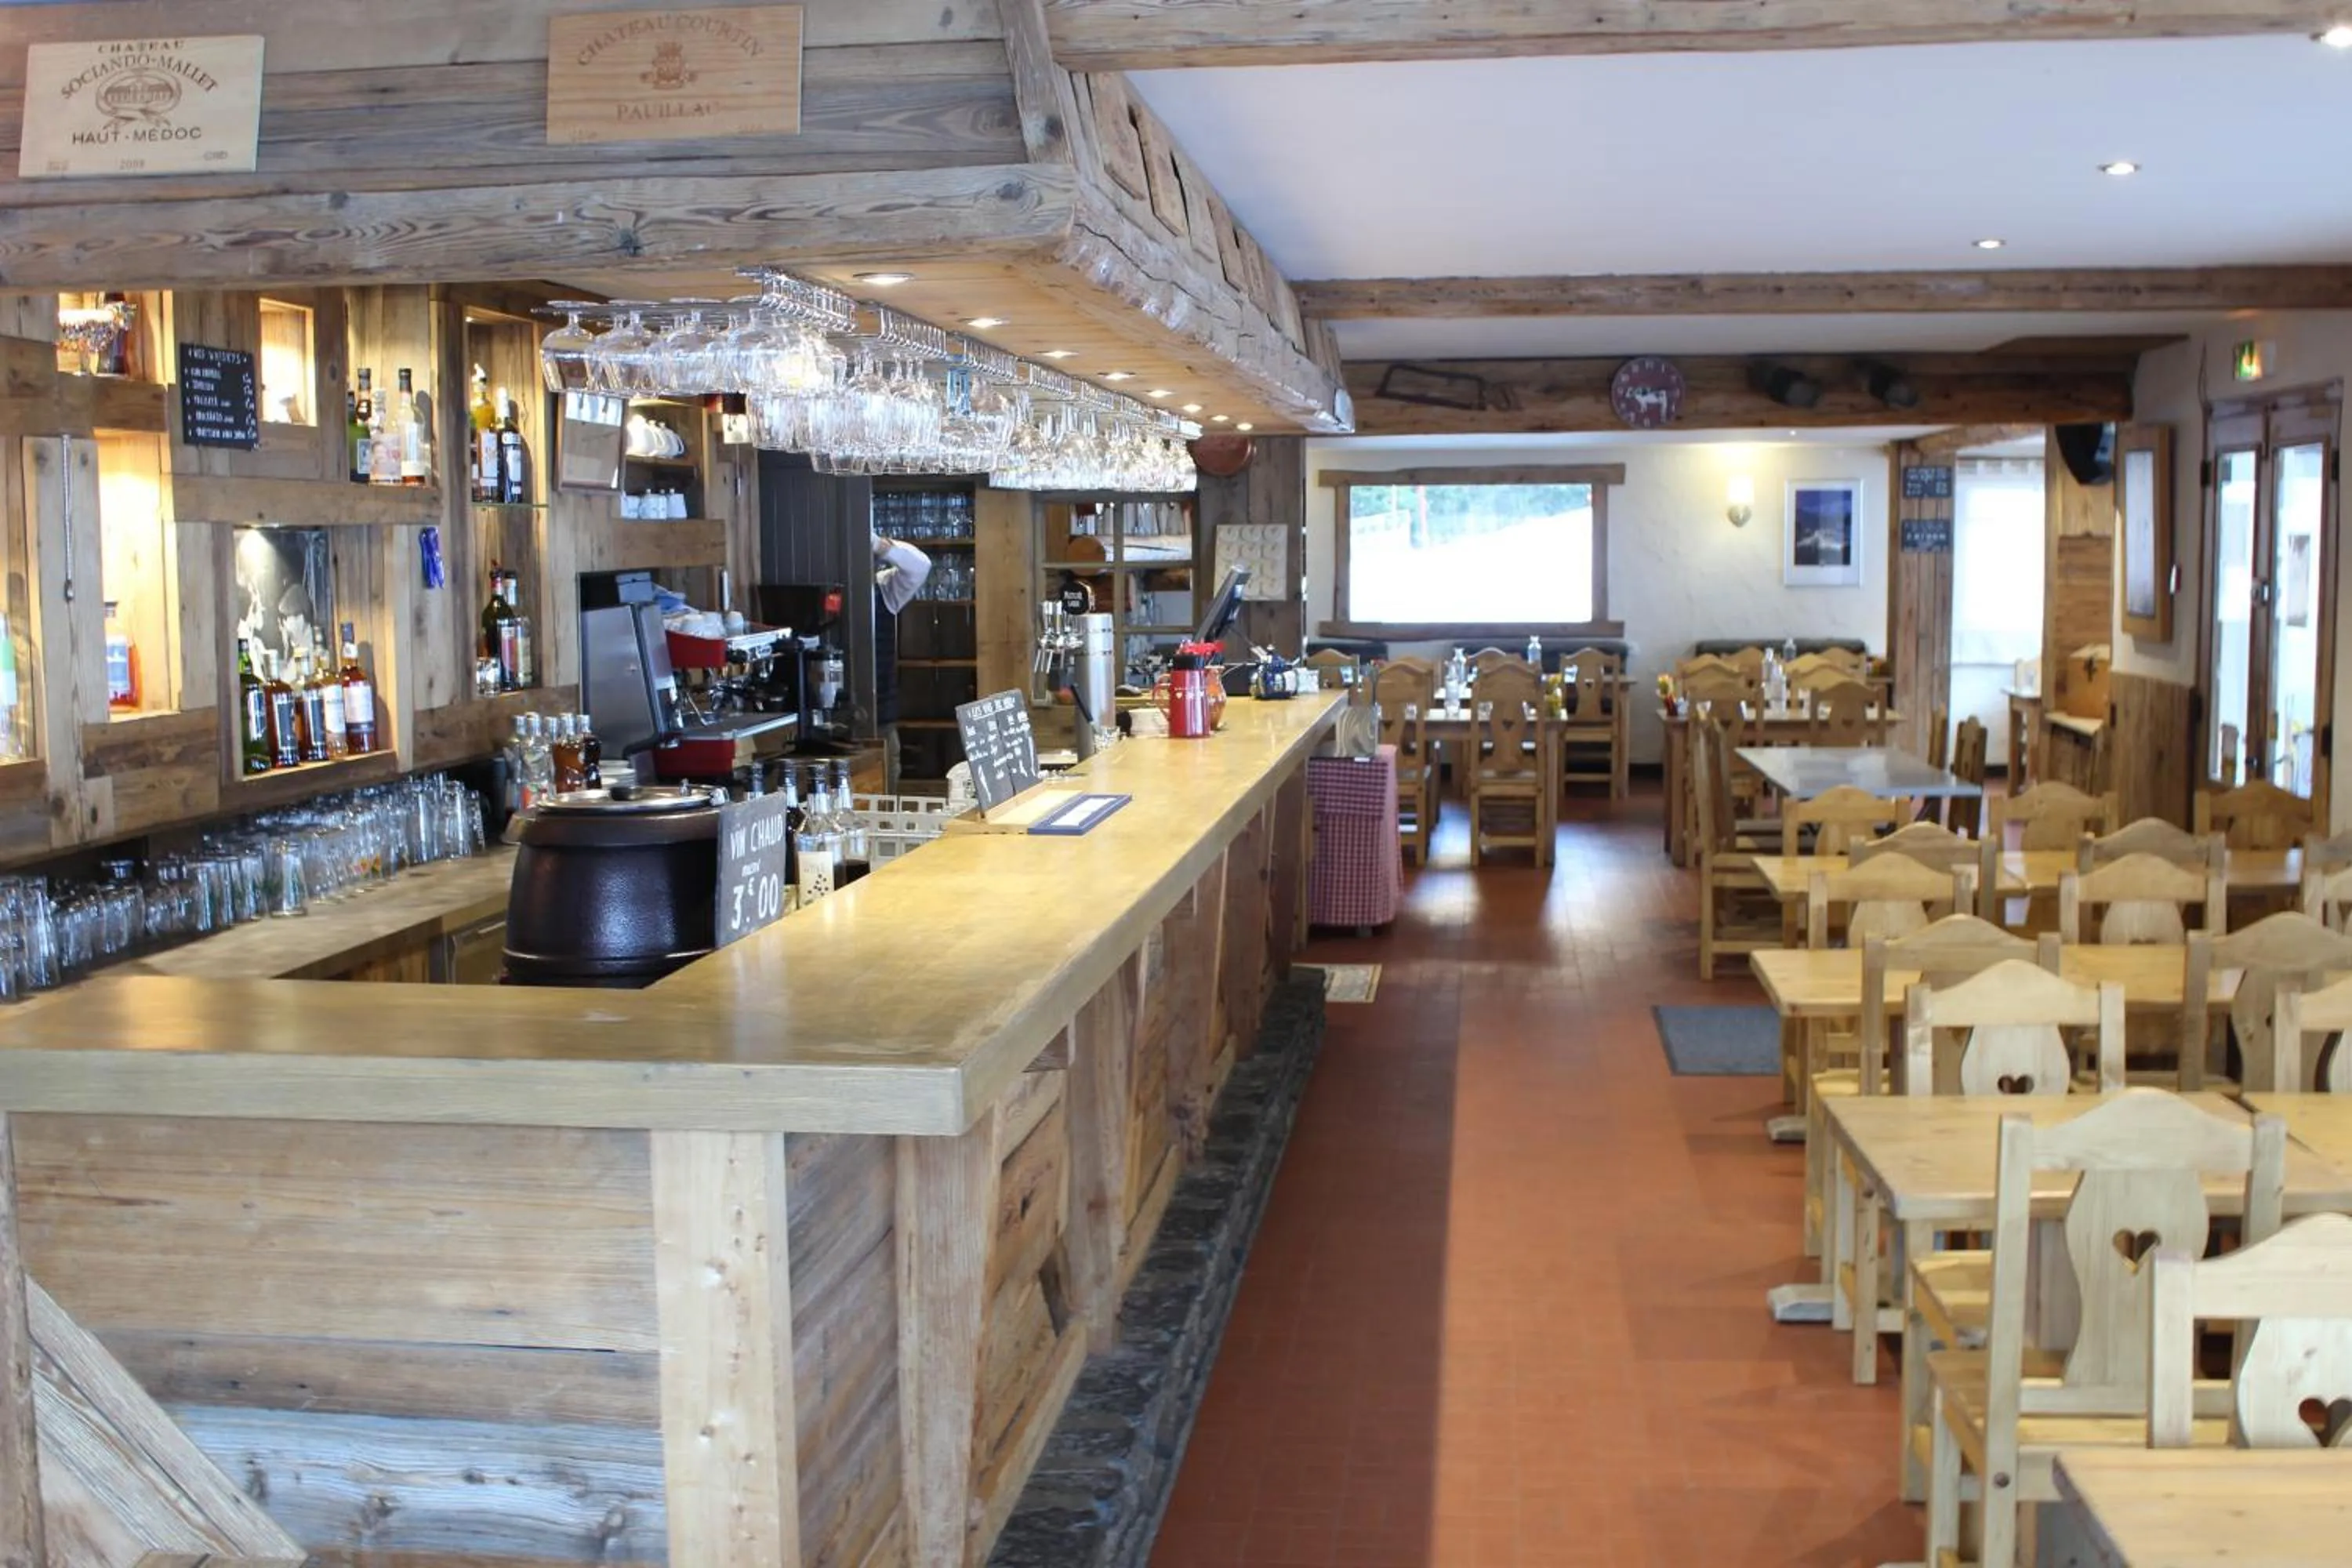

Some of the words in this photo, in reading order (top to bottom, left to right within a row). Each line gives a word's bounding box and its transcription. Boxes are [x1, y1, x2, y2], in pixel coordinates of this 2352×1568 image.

[616, 101, 720, 121] PAUILLAC
[730, 826, 746, 861] VIN
[750, 813, 783, 852] CHAUD
